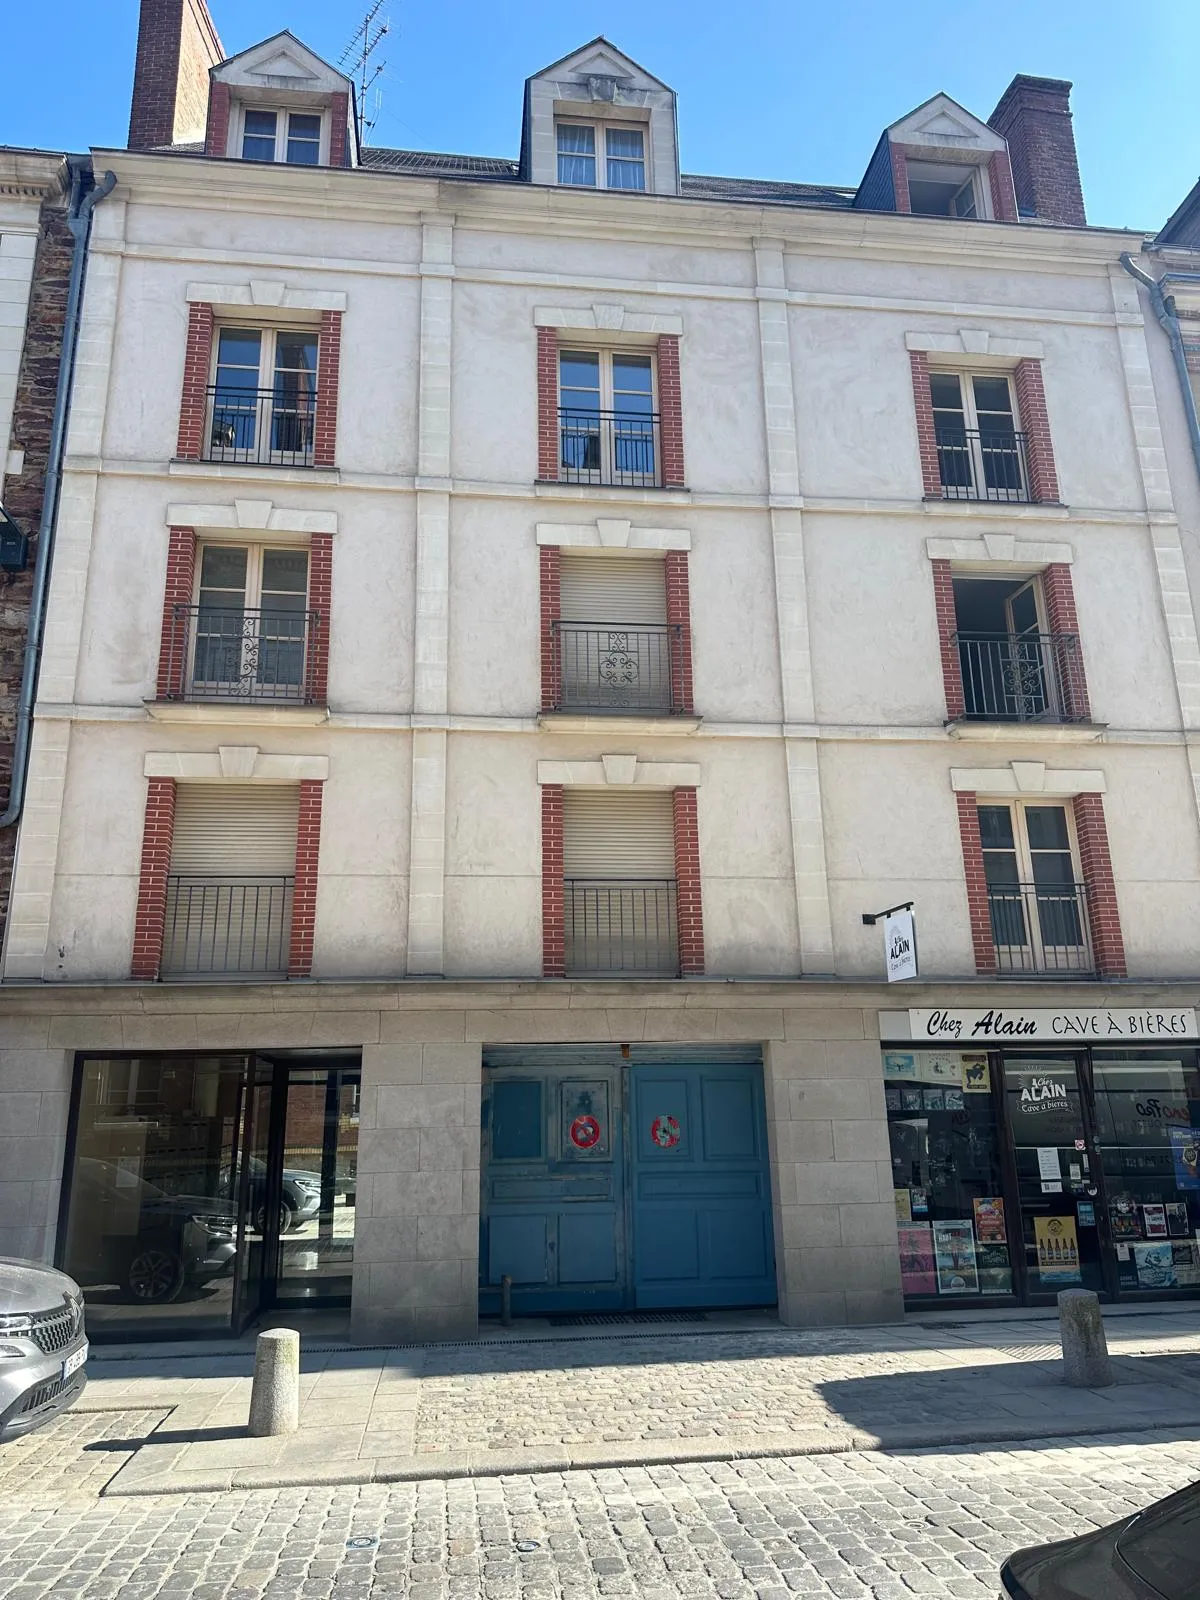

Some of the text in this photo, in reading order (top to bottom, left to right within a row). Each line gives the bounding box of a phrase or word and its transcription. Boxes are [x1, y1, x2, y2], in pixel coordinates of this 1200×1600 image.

[890, 940, 910, 959] ALAIN
[927, 1010, 1187, 1038] Chez Alain CAVE À BIÈRES
[1037, 1077, 1053, 1086] Chez
[1021, 1084, 1066, 1101] ALAIN
[1021, 1104, 1040, 1112] Cave
